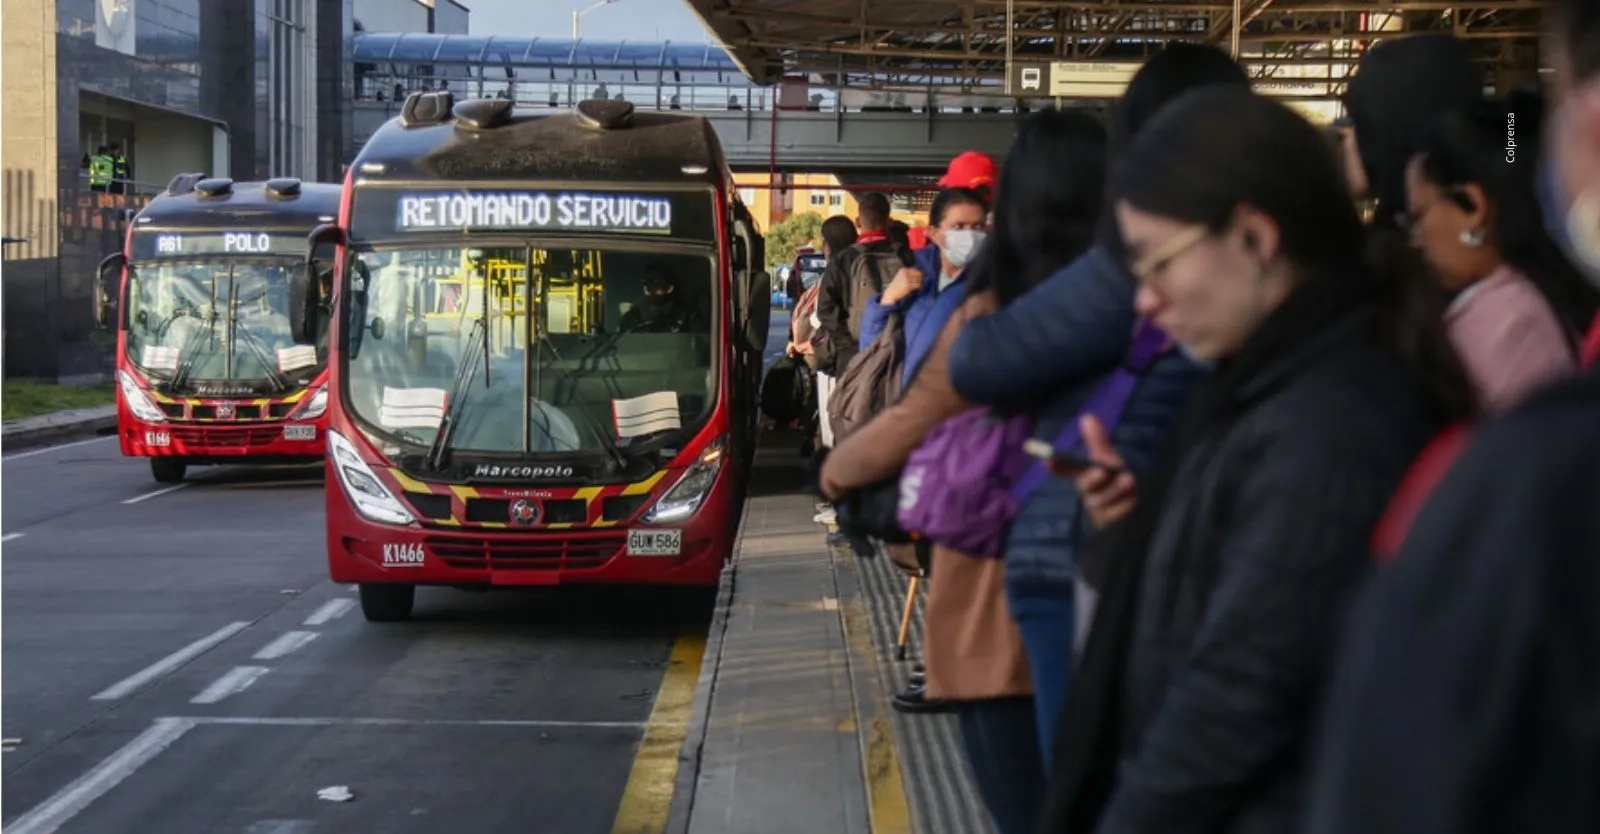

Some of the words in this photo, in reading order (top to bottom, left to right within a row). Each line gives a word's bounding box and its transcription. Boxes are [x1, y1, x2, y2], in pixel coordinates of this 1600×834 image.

[402, 195, 551, 227] RETOMANDO
[557, 196, 671, 227] SERVICIO
[224, 232, 270, 252] POLO
[474, 463, 574, 479] Marcopolo
[655, 532, 680, 548] 586
[383, 543, 425, 562] K1466
